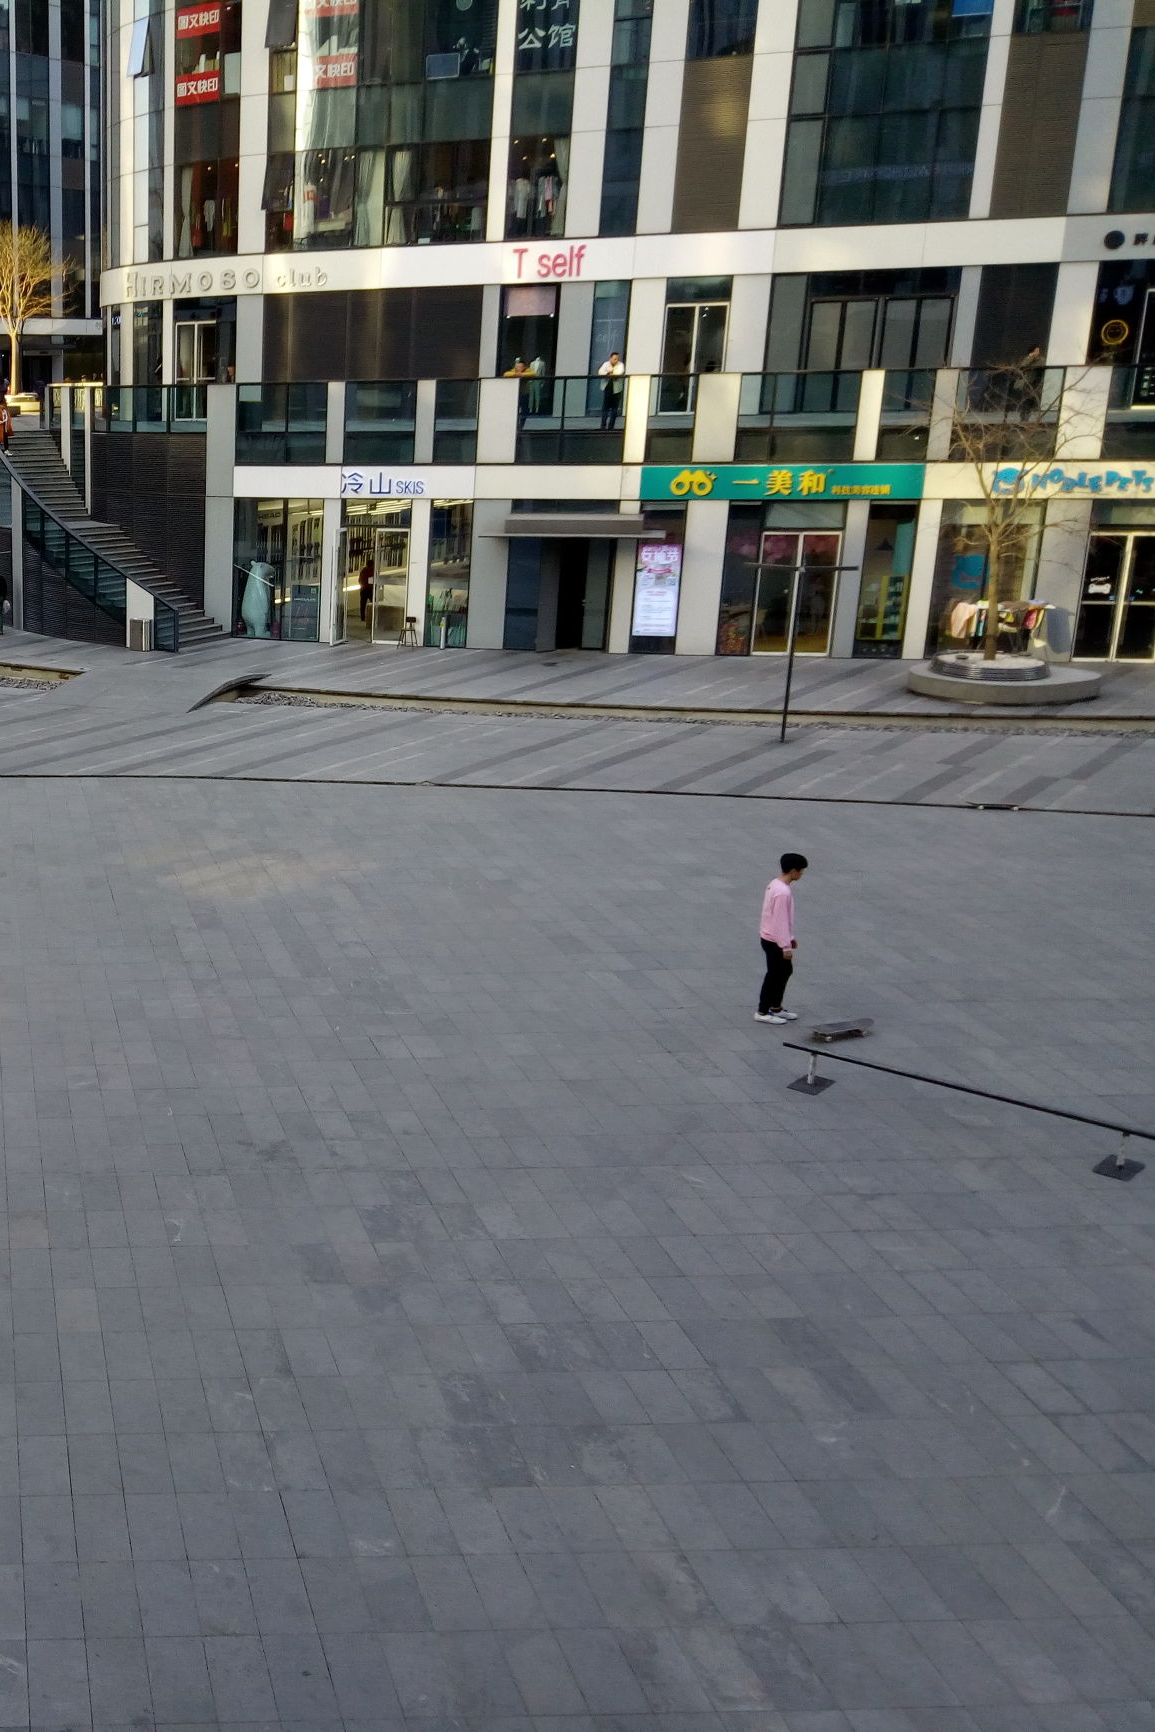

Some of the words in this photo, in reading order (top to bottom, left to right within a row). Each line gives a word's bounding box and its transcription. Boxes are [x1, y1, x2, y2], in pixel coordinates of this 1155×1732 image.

[517, 23, 576, 51] 公馆
[513, 248, 528, 279] T
[537, 244, 587, 278] self
[275, 266, 328, 287] club
[341, 472, 392, 495] 冷山
[395, 480, 425, 495] SKIS
[732, 469, 826, 496] 一美和
